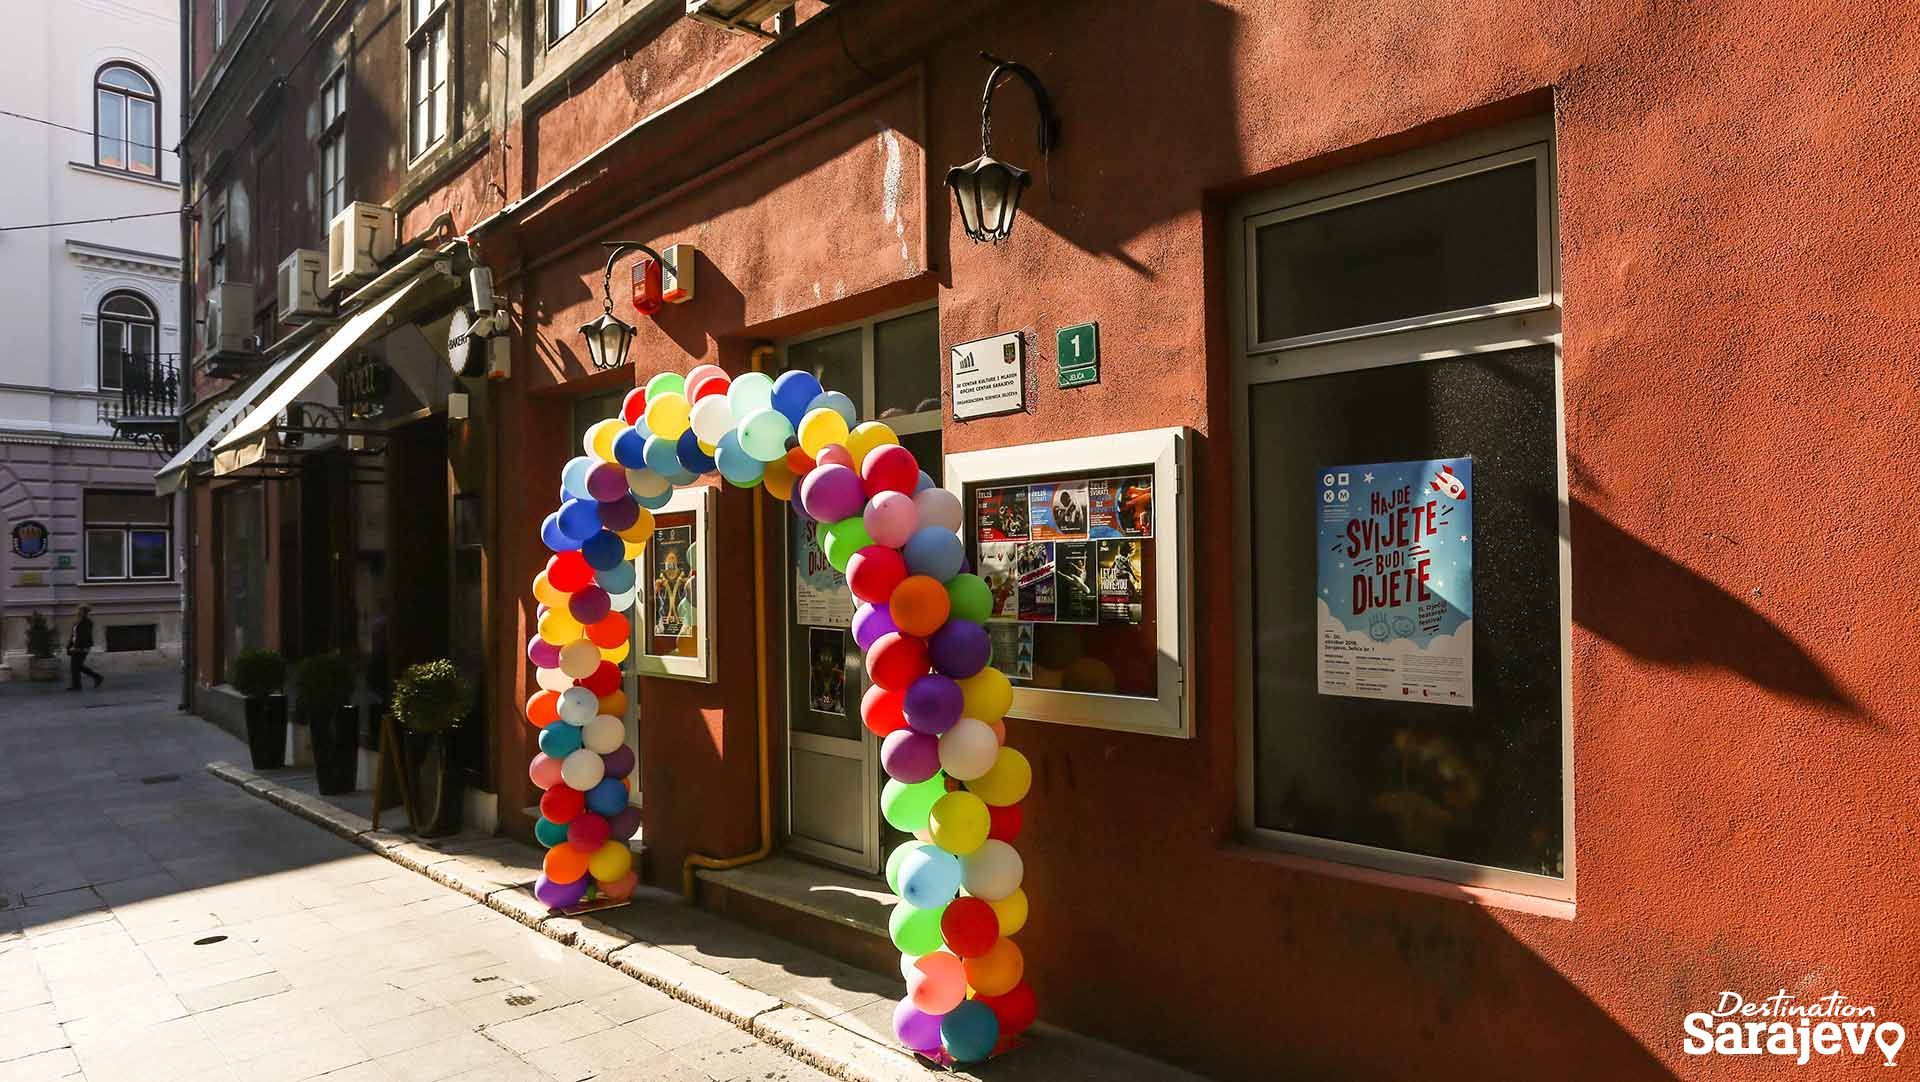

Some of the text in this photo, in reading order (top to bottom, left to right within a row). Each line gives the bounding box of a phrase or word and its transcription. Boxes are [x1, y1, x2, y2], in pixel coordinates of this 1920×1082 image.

[1070, 334, 1080, 358] 1
[1371, 485, 1410, 515] HAJDE
[1347, 500, 1437, 559] SVIJETE
[1376, 551, 1405, 575] BUDI
[1353, 559, 1431, 615] DIJETE
